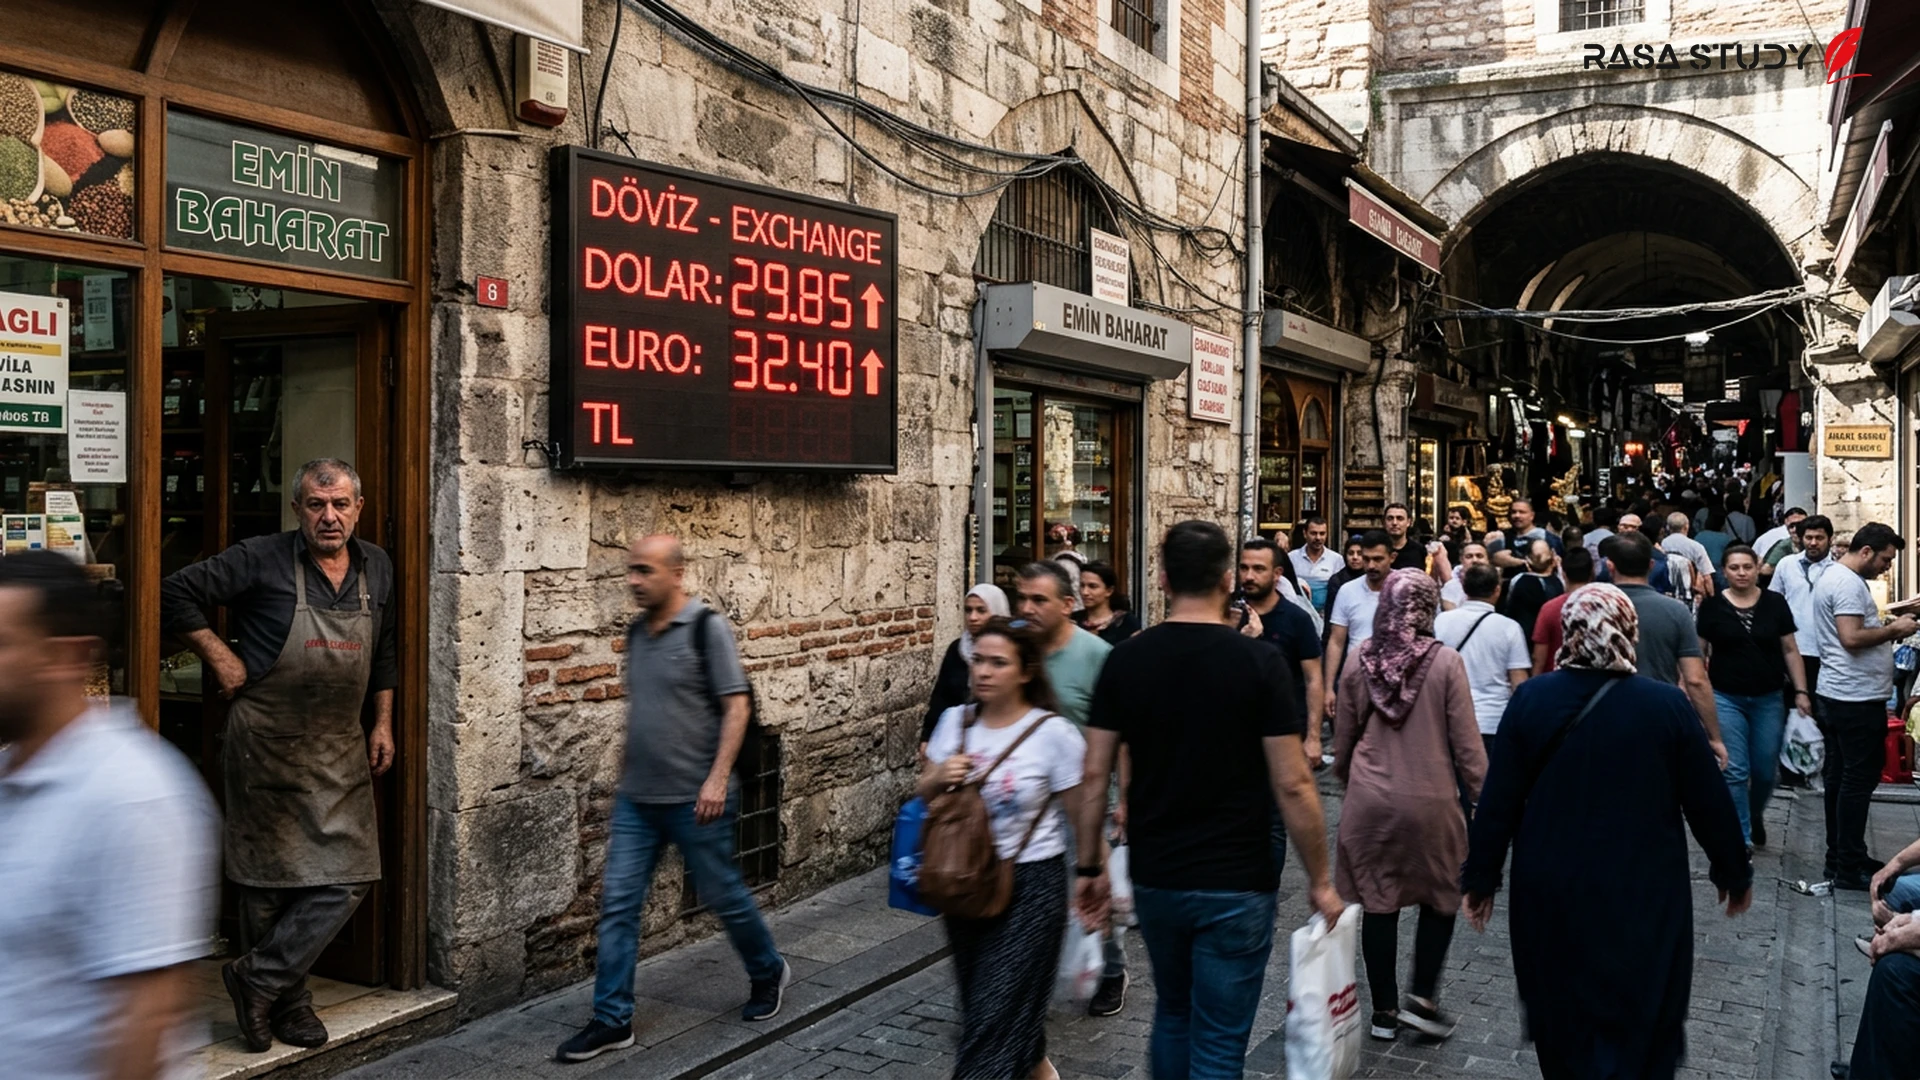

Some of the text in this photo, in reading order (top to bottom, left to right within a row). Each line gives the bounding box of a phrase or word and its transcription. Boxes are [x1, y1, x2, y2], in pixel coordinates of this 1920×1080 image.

[232, 140, 341, 202] EMİN
[176, 188, 389, 262] BAHARAT
[591, 176, 699, 233] DÖVİZ
[731, 205, 882, 265] EXCHANGE
[584, 247, 852, 329] DOLAR: 29.85
[584, 325, 853, 396] EURO: 32.40
[1063, 302, 1100, 336] EMİN
[1105, 313, 1168, 350] BAHARAT
[582, 402, 634, 445] TL
